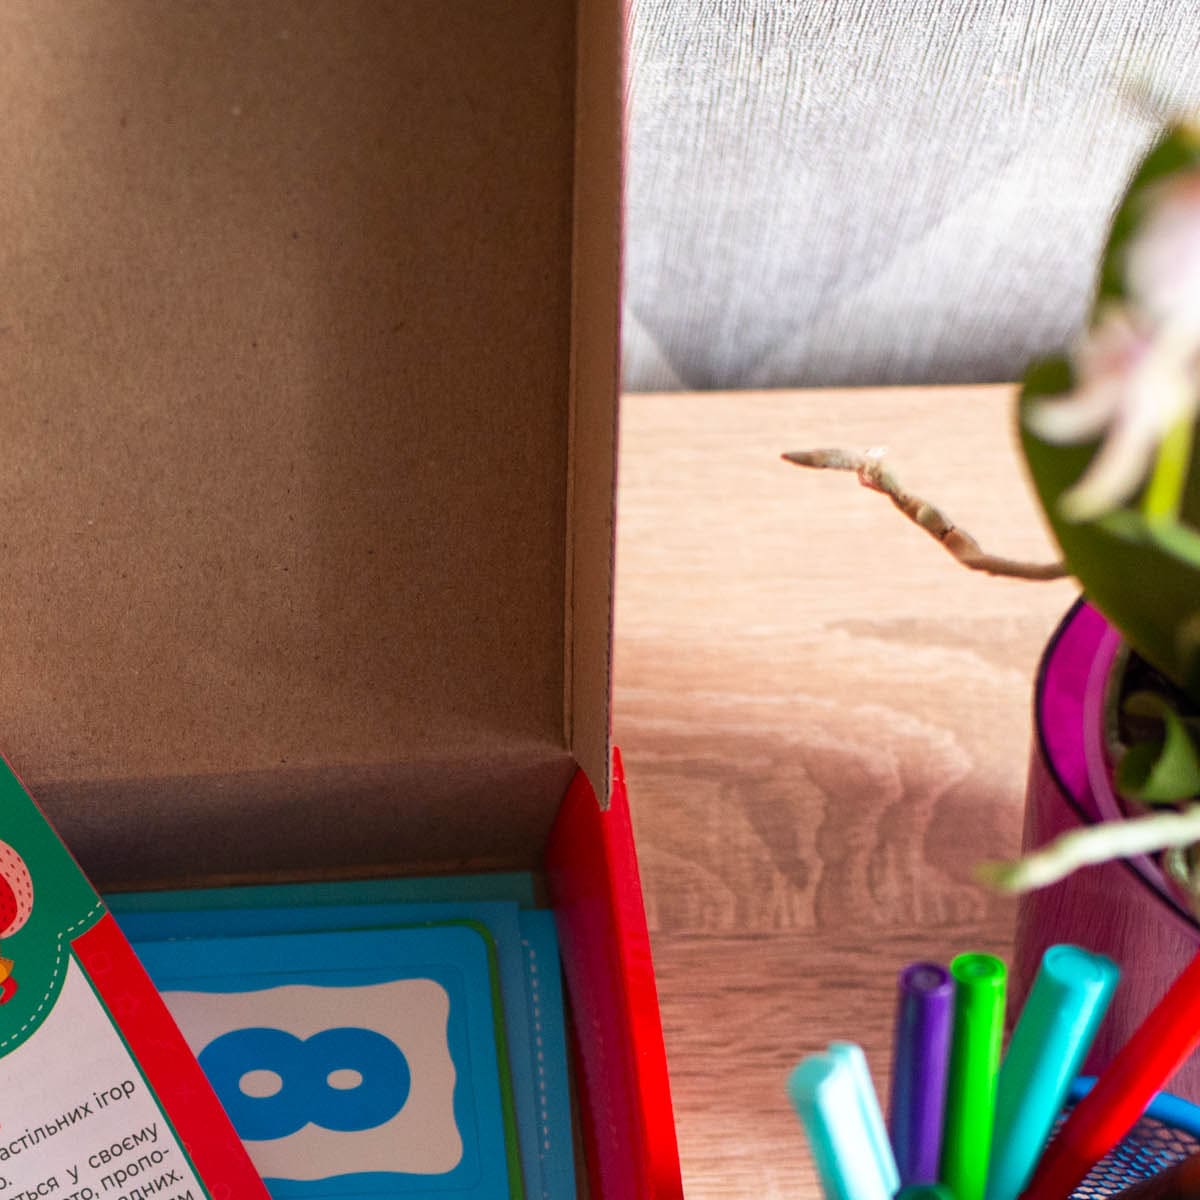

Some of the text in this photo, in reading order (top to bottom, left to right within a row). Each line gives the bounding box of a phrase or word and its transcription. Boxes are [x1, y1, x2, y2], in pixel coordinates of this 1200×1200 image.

[92, 1079, 136, 1109] ігор
[196, 1027, 411, 1141] 8
[65, 1163, 79, 1186] у
[87, 1121, 158, 1169] своєму
